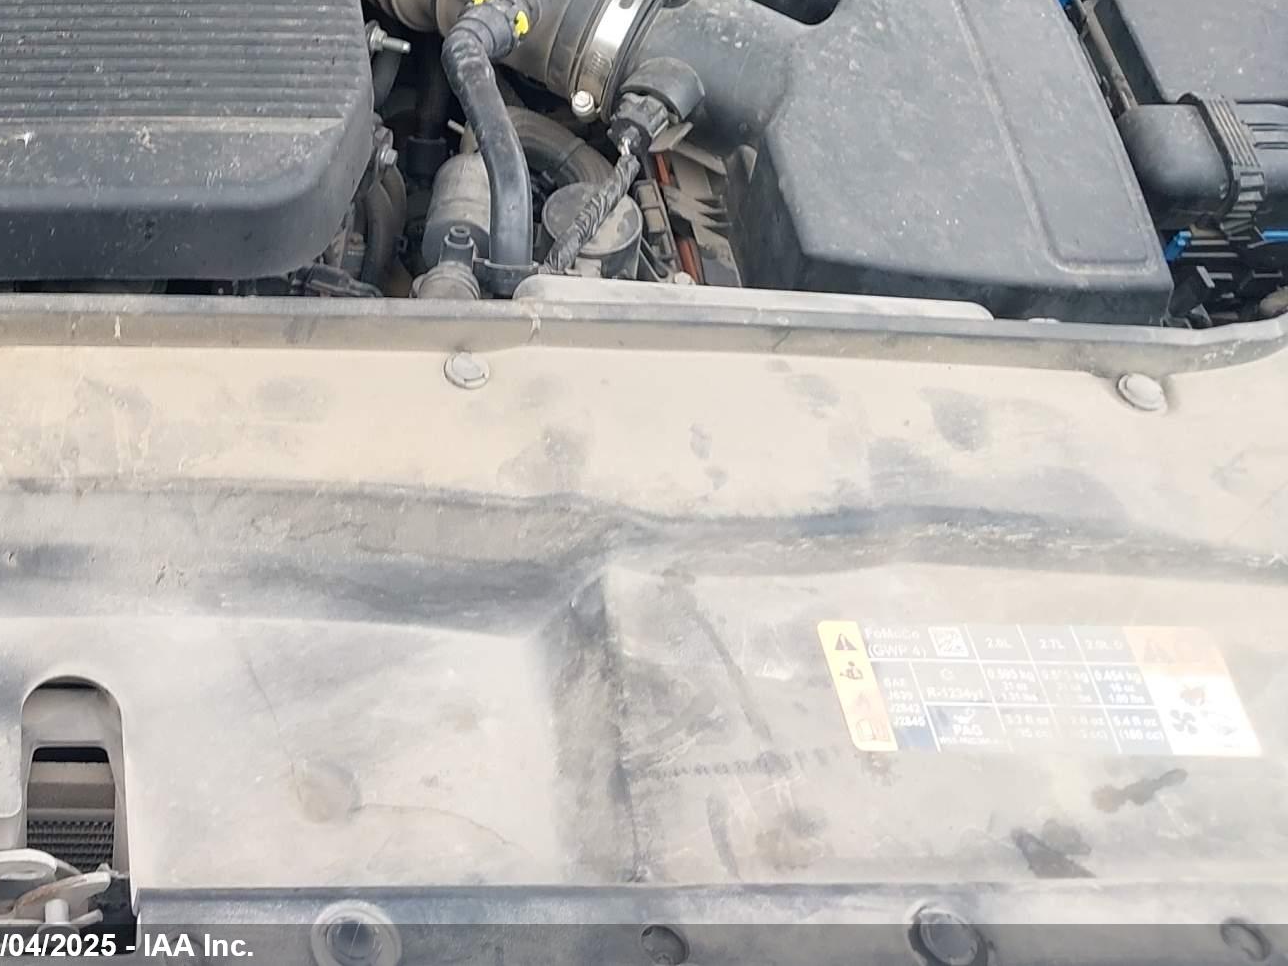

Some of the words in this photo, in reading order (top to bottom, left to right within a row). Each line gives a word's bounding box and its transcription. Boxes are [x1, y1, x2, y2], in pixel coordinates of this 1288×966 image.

[868, 644, 908, 658] (GWP
[1039, 638, 1065, 650] 2.7L
[1019, 668, 1036, 682] kg
[926, 687, 985, 701] R-1234yf
[952, 724, 983, 736] PAG
